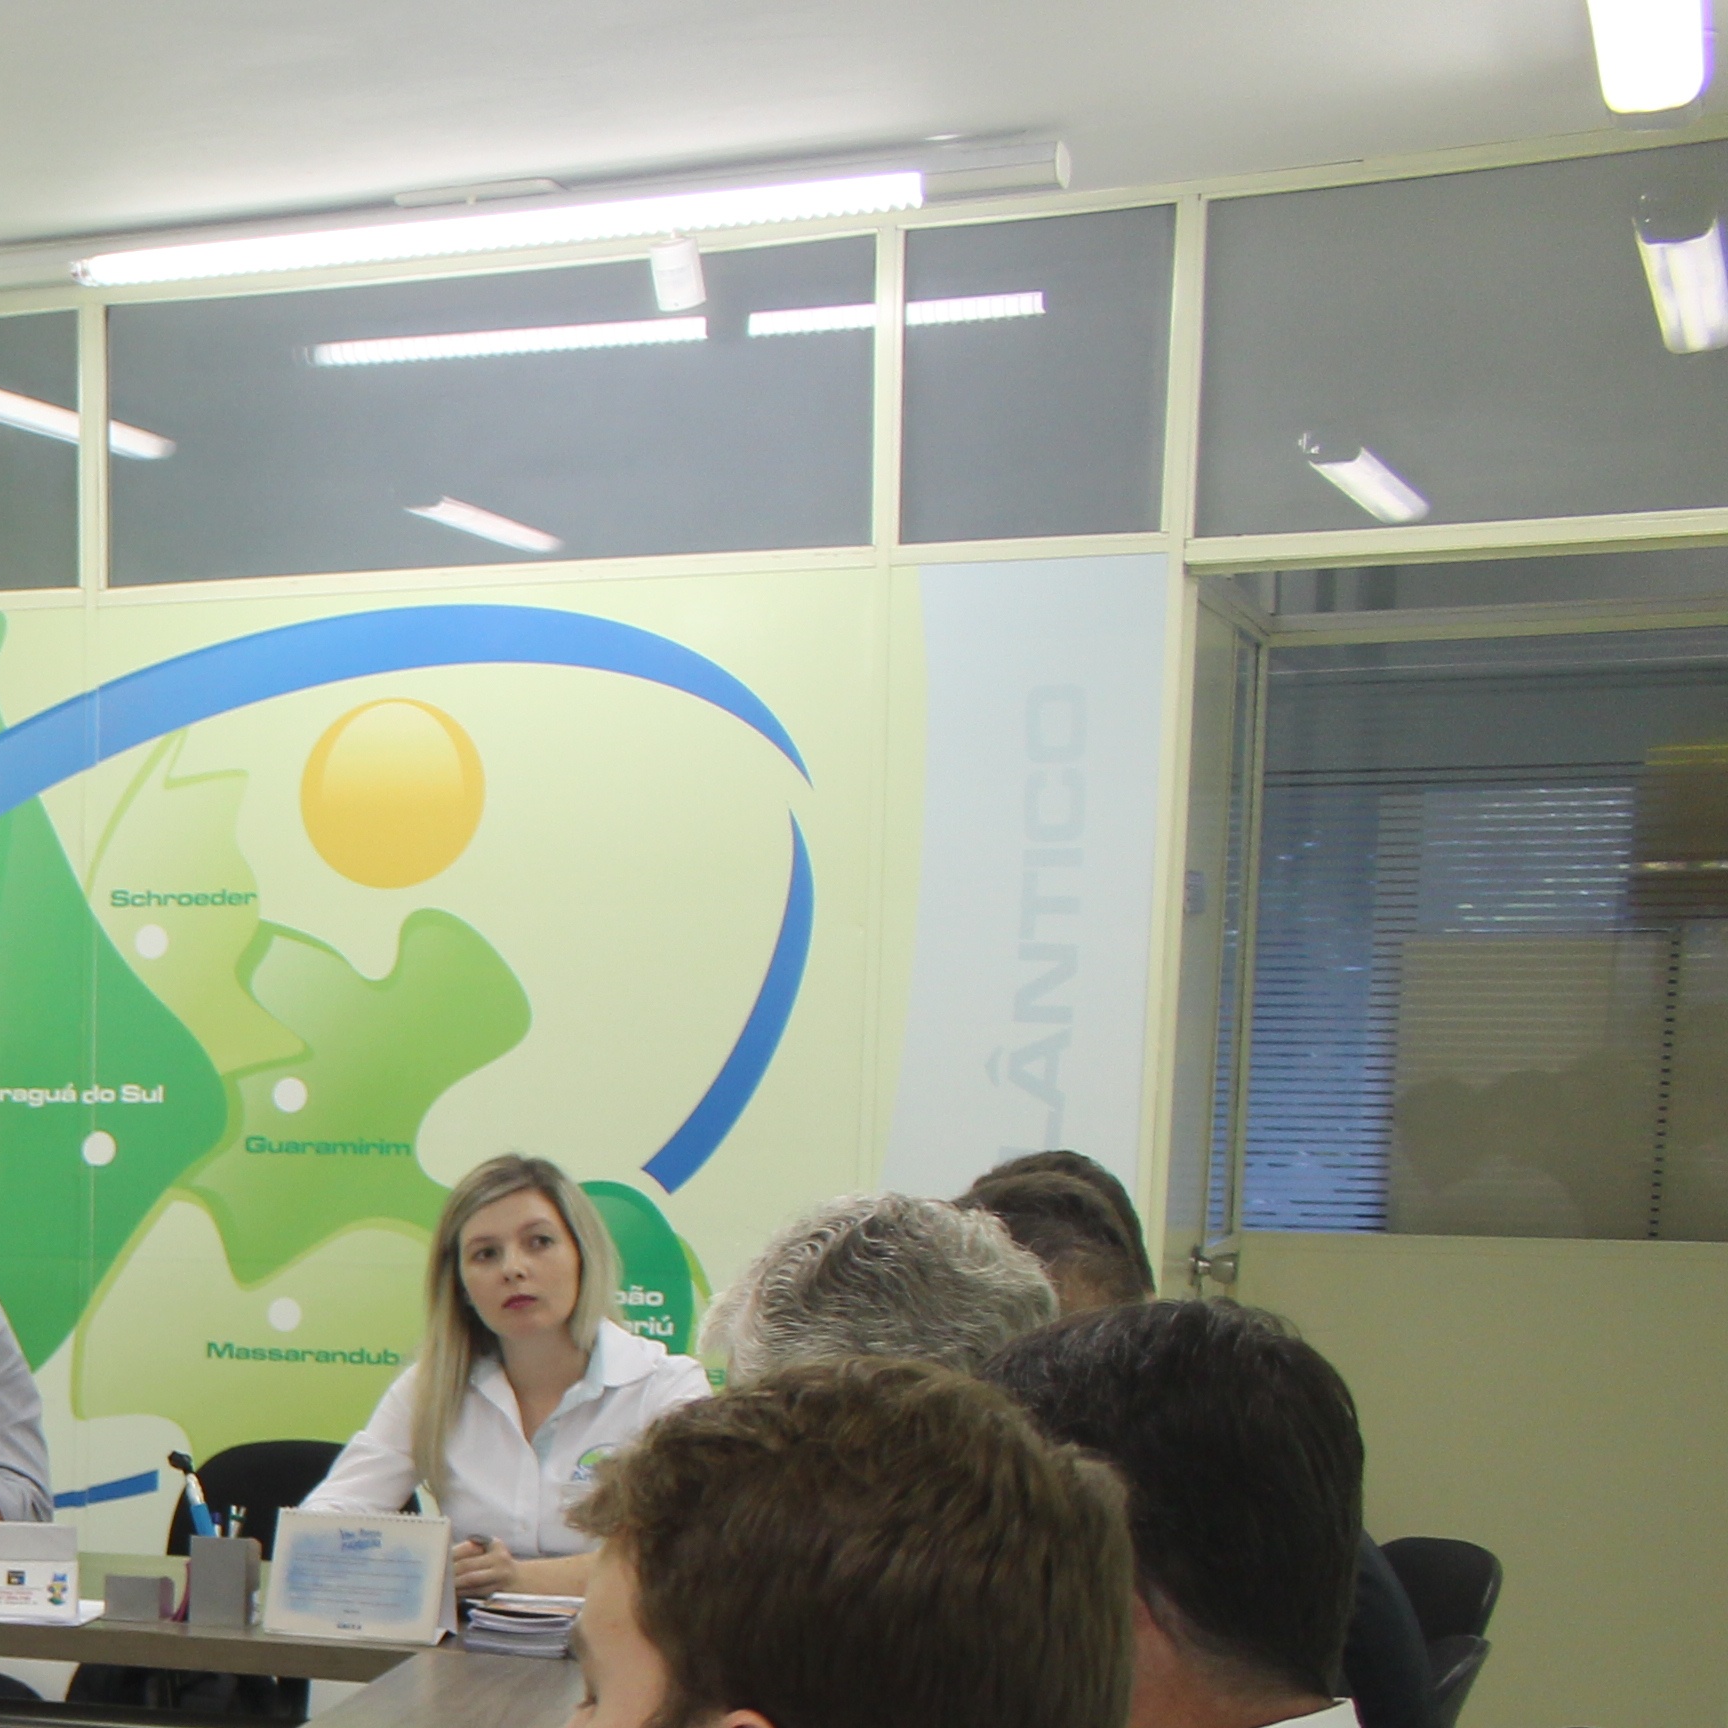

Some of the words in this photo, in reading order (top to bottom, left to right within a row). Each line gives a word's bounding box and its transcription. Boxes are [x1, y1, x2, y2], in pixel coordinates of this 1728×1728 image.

[109, 888, 258, 909] Schroeder
[81, 1082, 115, 1106] do
[121, 1084, 166, 1106] Sul
[245, 1136, 412, 1156] Guaramirim
